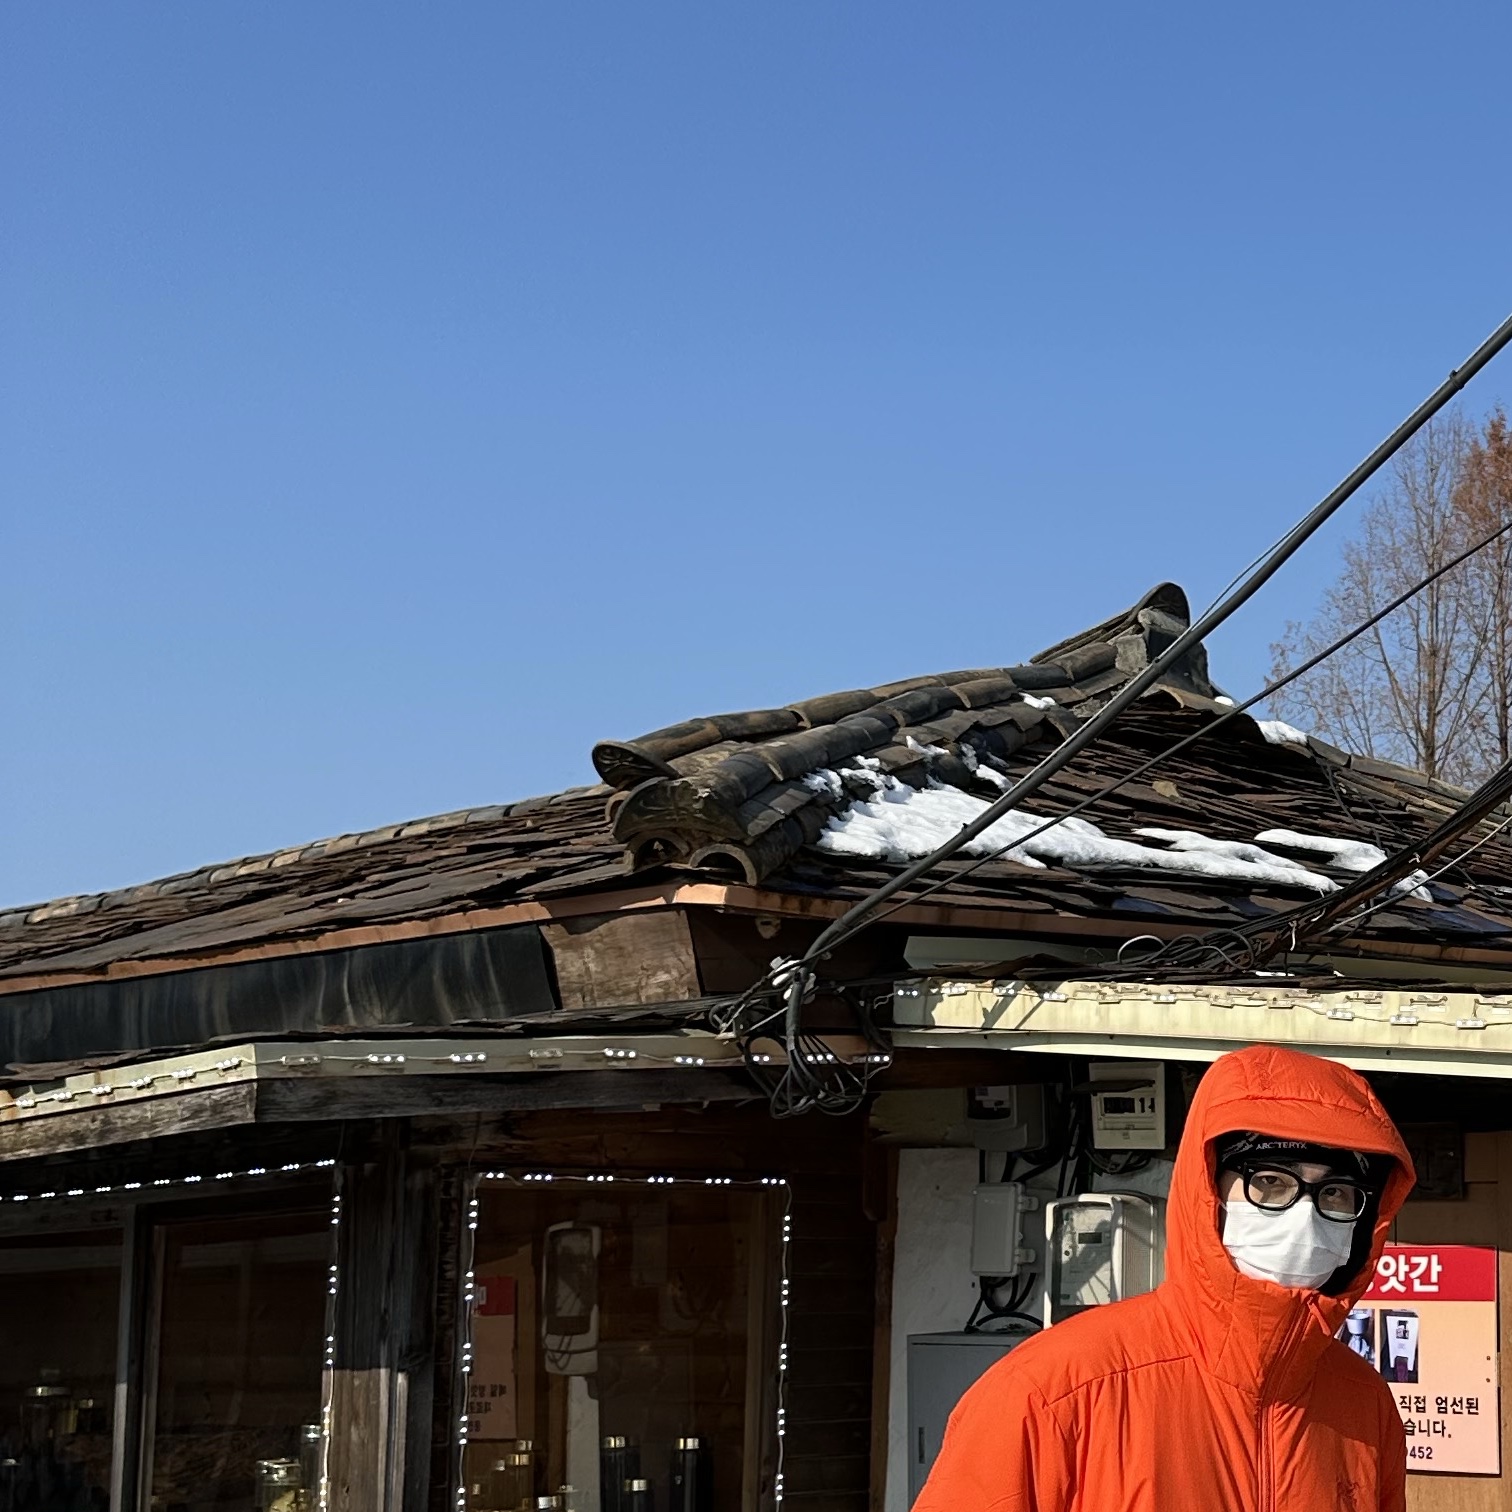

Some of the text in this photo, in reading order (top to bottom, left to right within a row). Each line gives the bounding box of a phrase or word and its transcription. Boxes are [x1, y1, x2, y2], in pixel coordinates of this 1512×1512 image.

[1365, 1254, 1443, 1293] 앗간
[1399, 1395, 1480, 1416] 직접 엄선된
[1405, 1446, 1434, 1460] 452
